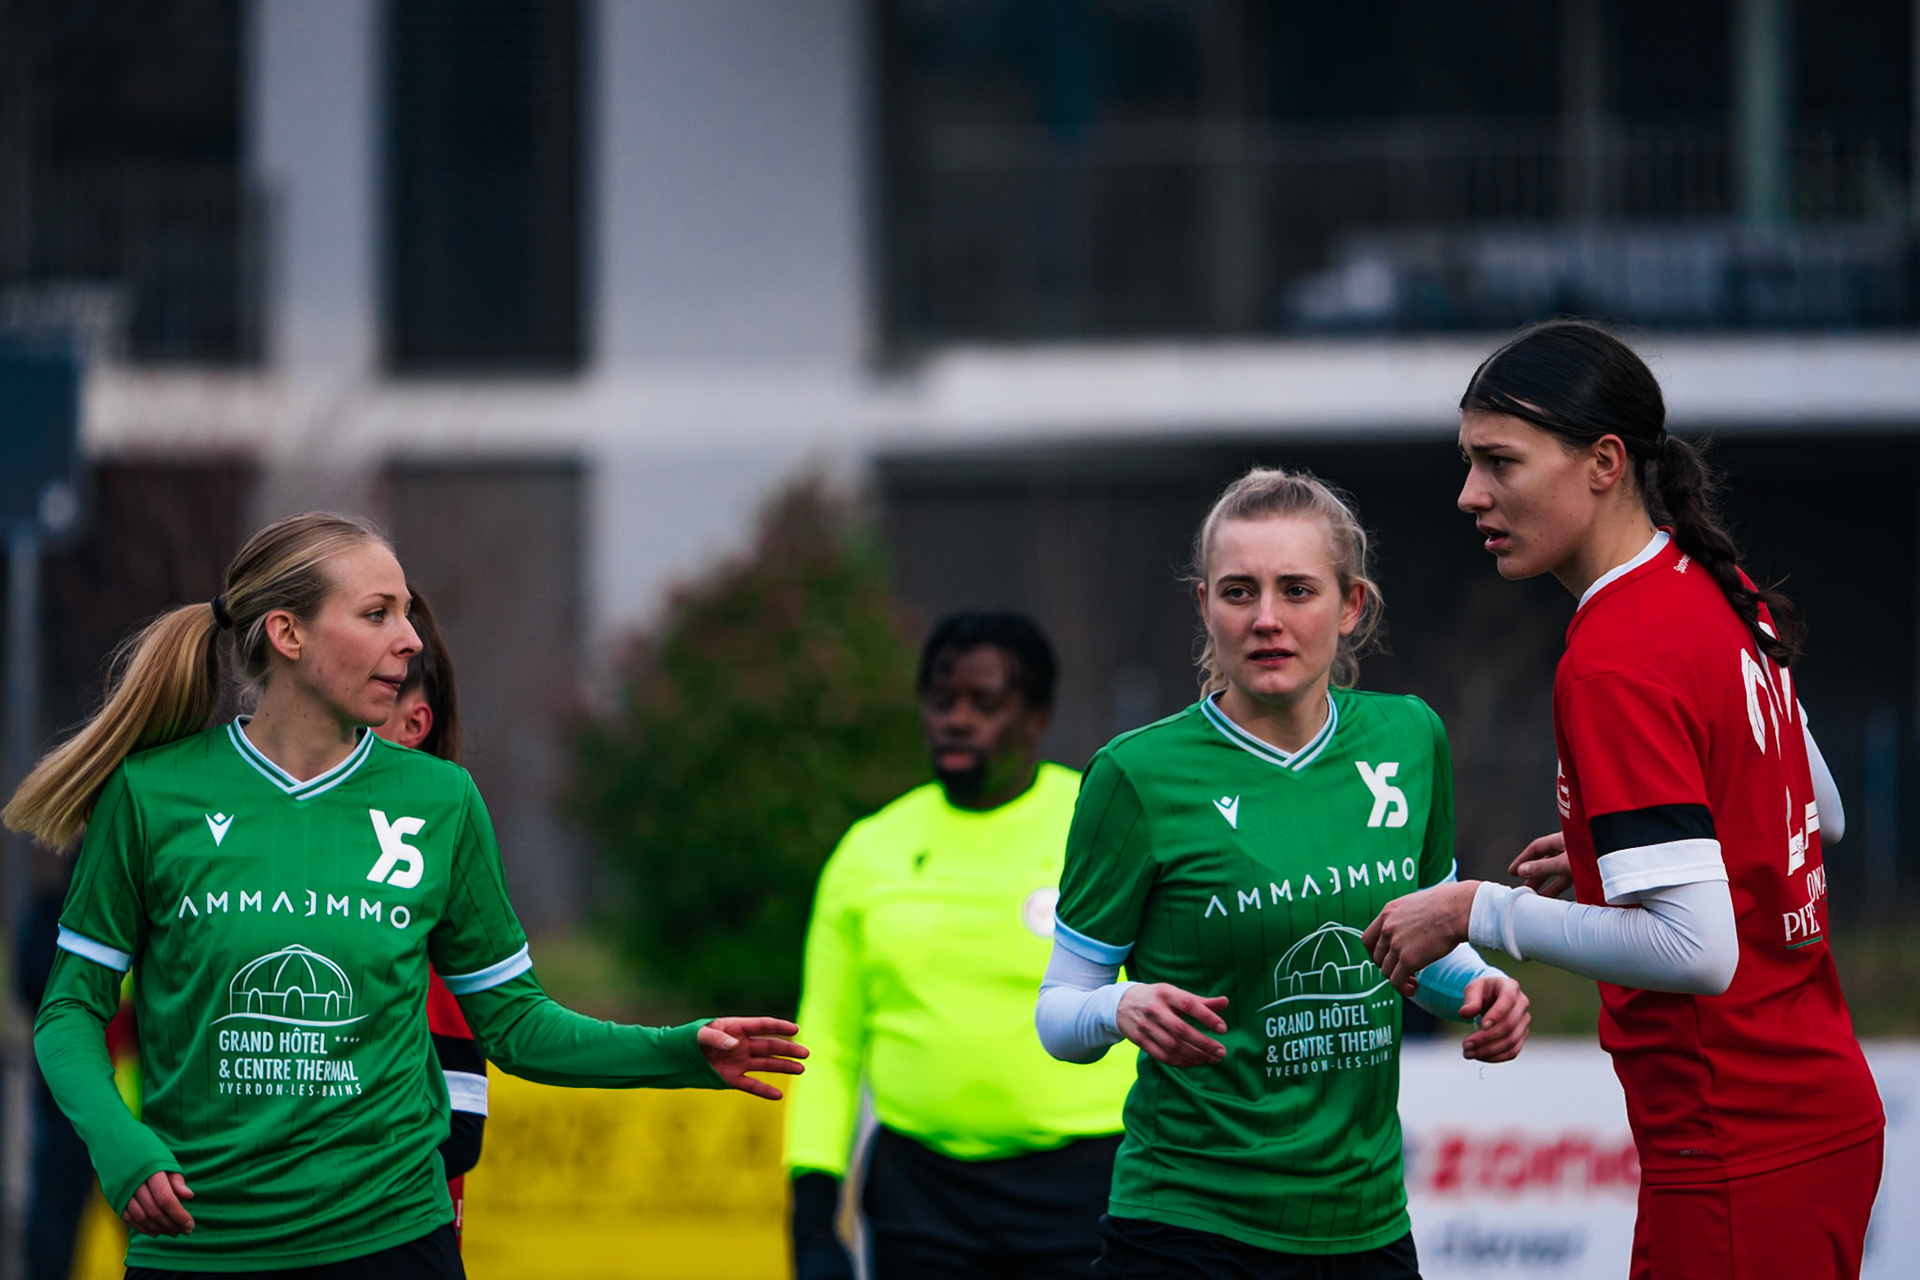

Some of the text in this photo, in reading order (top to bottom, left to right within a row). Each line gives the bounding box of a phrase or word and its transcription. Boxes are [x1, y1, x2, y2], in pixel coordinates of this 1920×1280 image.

[1265, 1002, 1369, 1038] GRAND HÔTEL
[219, 1027, 328, 1054] GRAND HÔTEL
[1266, 1025, 1393, 1063] & CENTRE THERMAL
[219, 1058, 359, 1081] & CENTRE THERMAL
